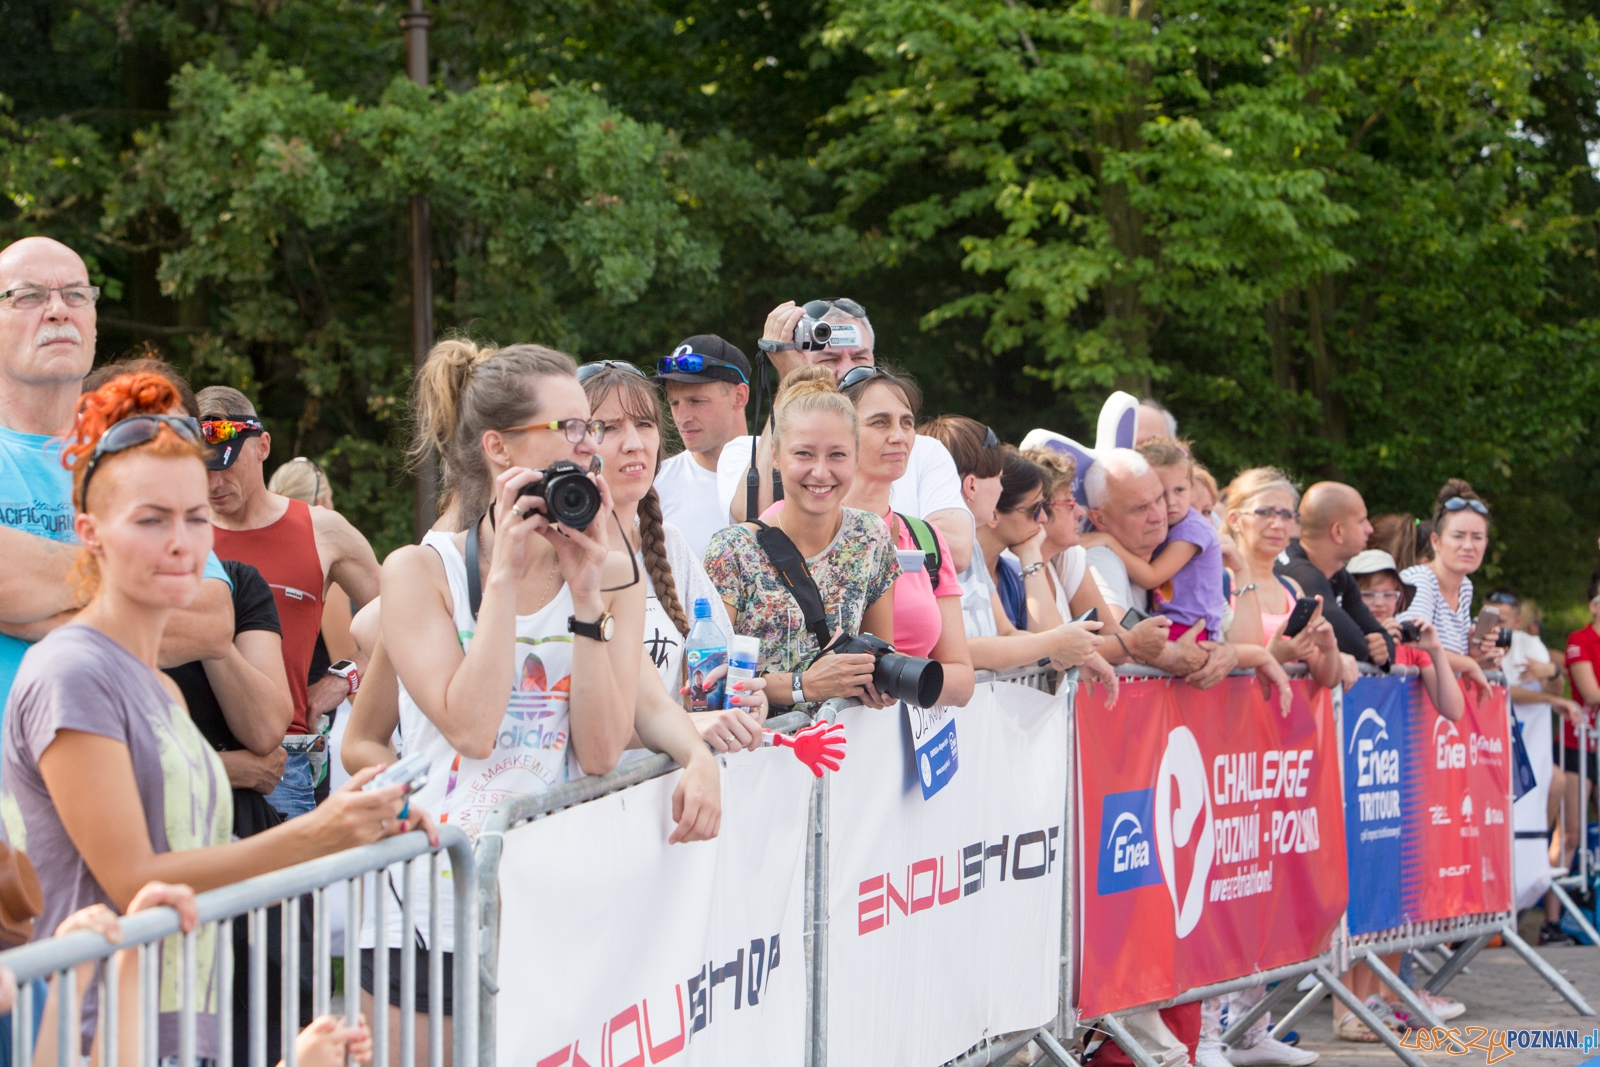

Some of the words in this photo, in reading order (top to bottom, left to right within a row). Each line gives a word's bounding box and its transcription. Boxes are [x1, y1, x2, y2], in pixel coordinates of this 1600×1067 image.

[493, 724, 566, 750] didas
[1357, 738, 1400, 787] Enea
[1358, 790, 1401, 822] TRITOUR
[1114, 835, 1150, 873] Enea
